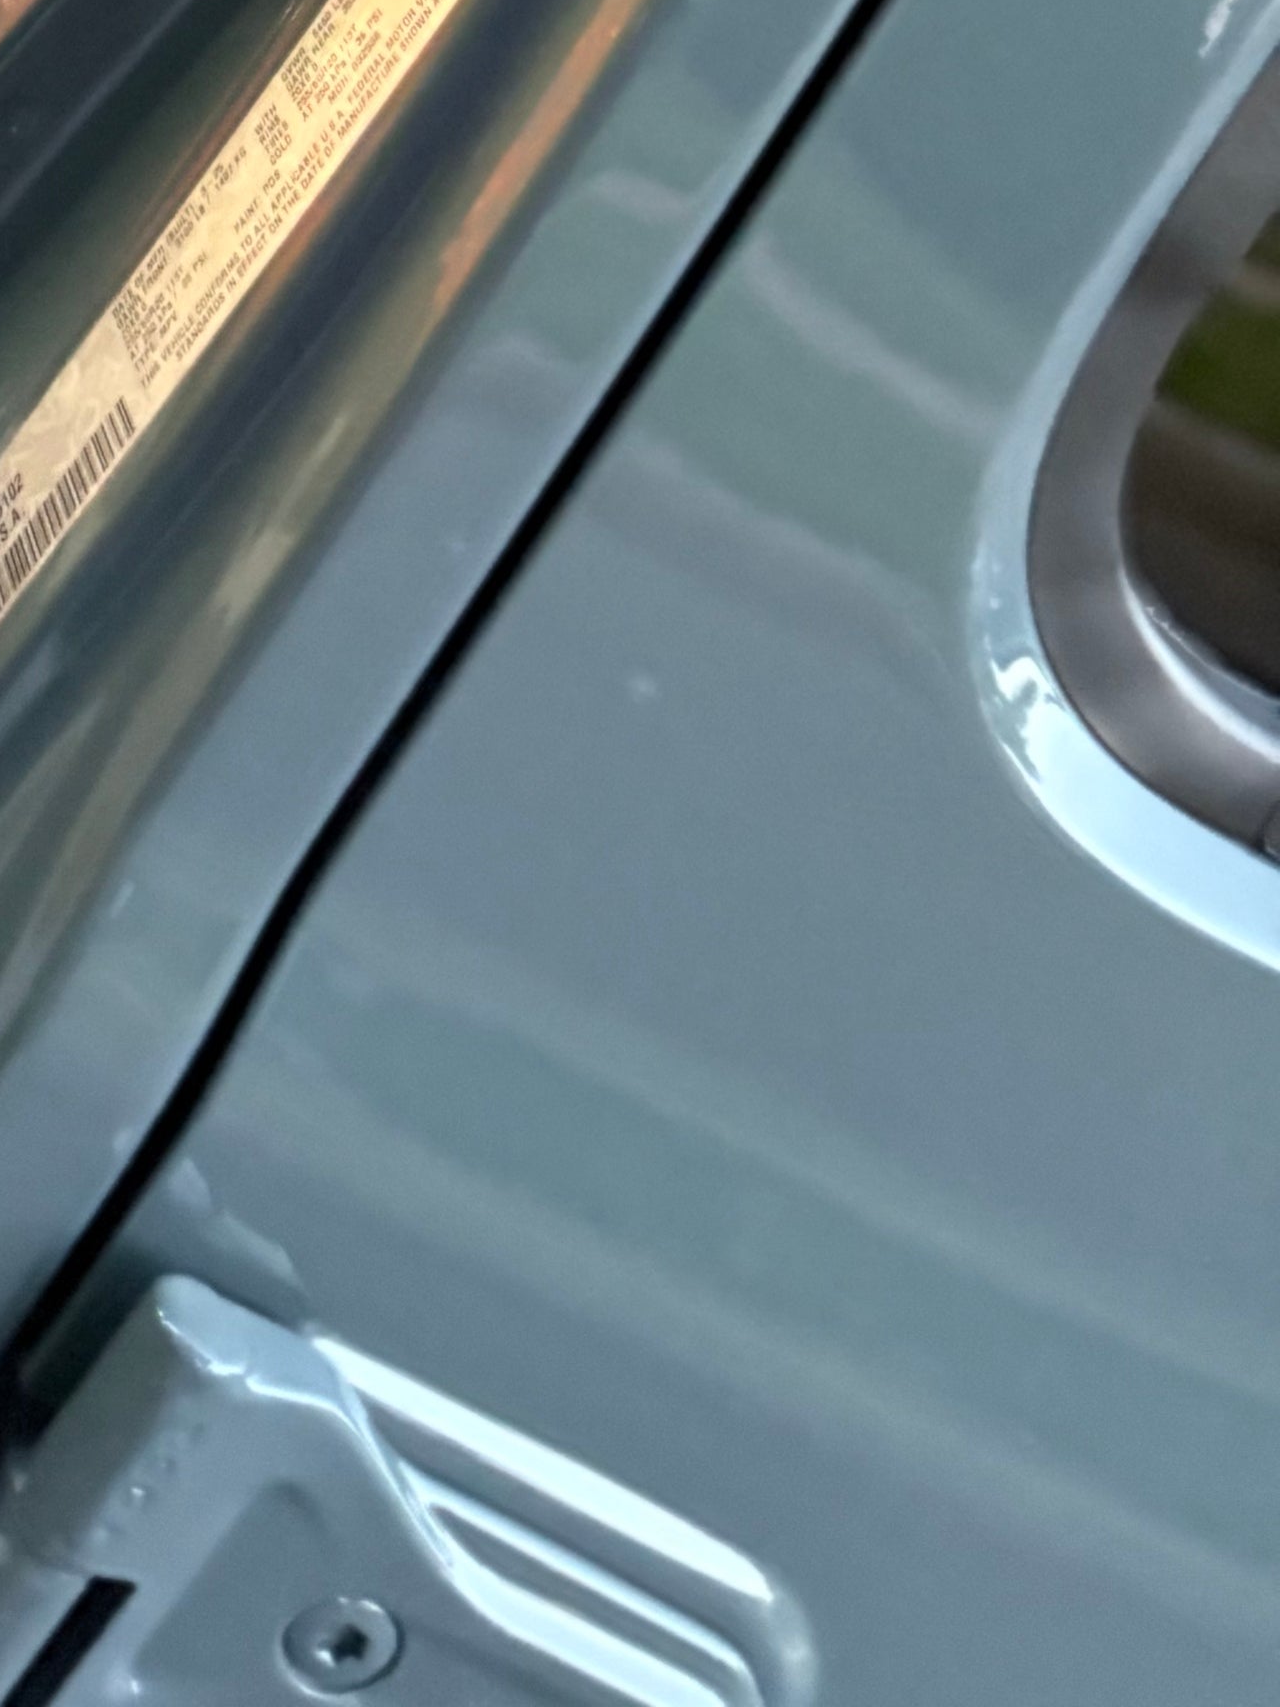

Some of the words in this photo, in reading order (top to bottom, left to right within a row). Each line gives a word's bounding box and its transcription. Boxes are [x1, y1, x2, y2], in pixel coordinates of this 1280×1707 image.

[159, 311, 195, 364] VEHICLE
[193, 249, 241, 318] CONFORMS
[251, 207, 271, 238] ALL
[268, 139, 321, 214] APPLICABLE
[346, 49, 386, 107] FEDERAL
[383, 5, 417, 53] MOTOR
[174, 288, 226, 364] STANDARDS
[235, 230, 269, 281] EFFECT
[299, 153, 326, 193] DATE
[335, 48, 402, 142] MANUFACTURE
[398, 3, 435, 54] SHOWN
